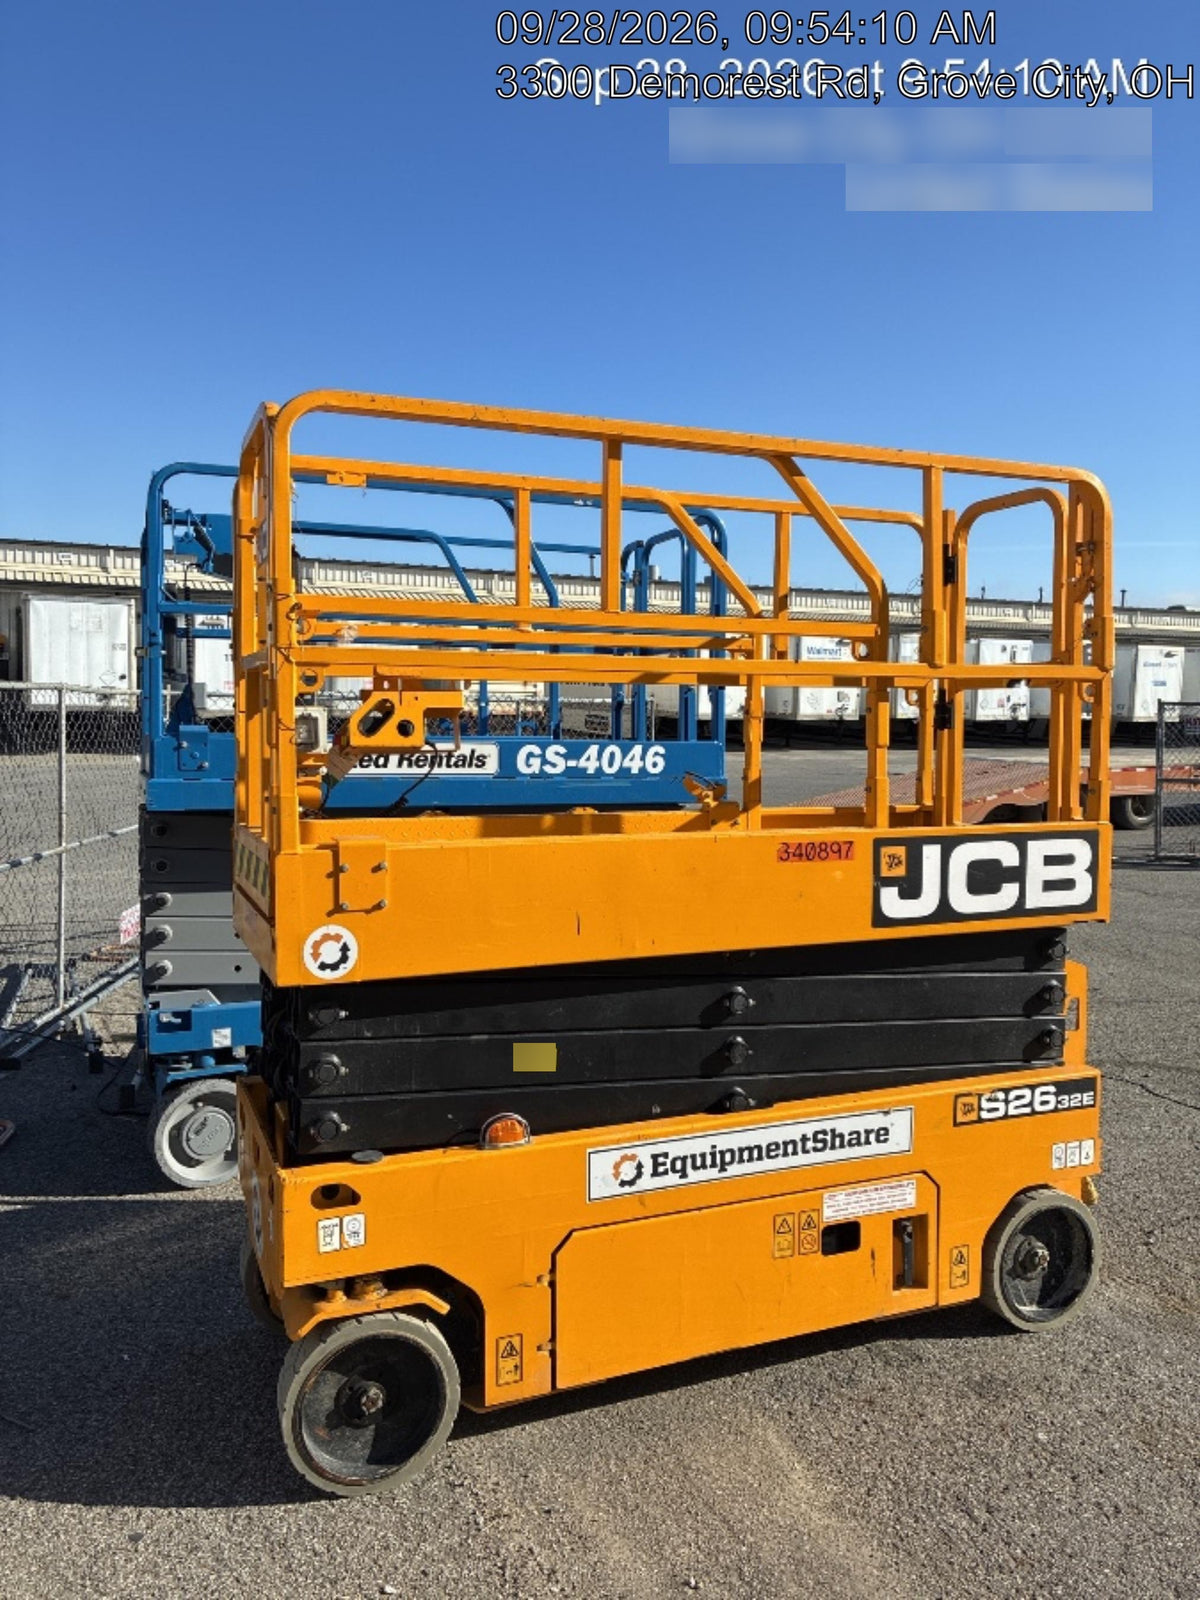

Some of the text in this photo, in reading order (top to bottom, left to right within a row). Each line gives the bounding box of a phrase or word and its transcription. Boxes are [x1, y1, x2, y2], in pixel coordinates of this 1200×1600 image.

[516, 744, 666, 774] GS-4046
[778, 841, 854, 861] 340897
[880, 838, 1093, 919] JCB
[650, 1126, 890, 1179] EquipmentShare
